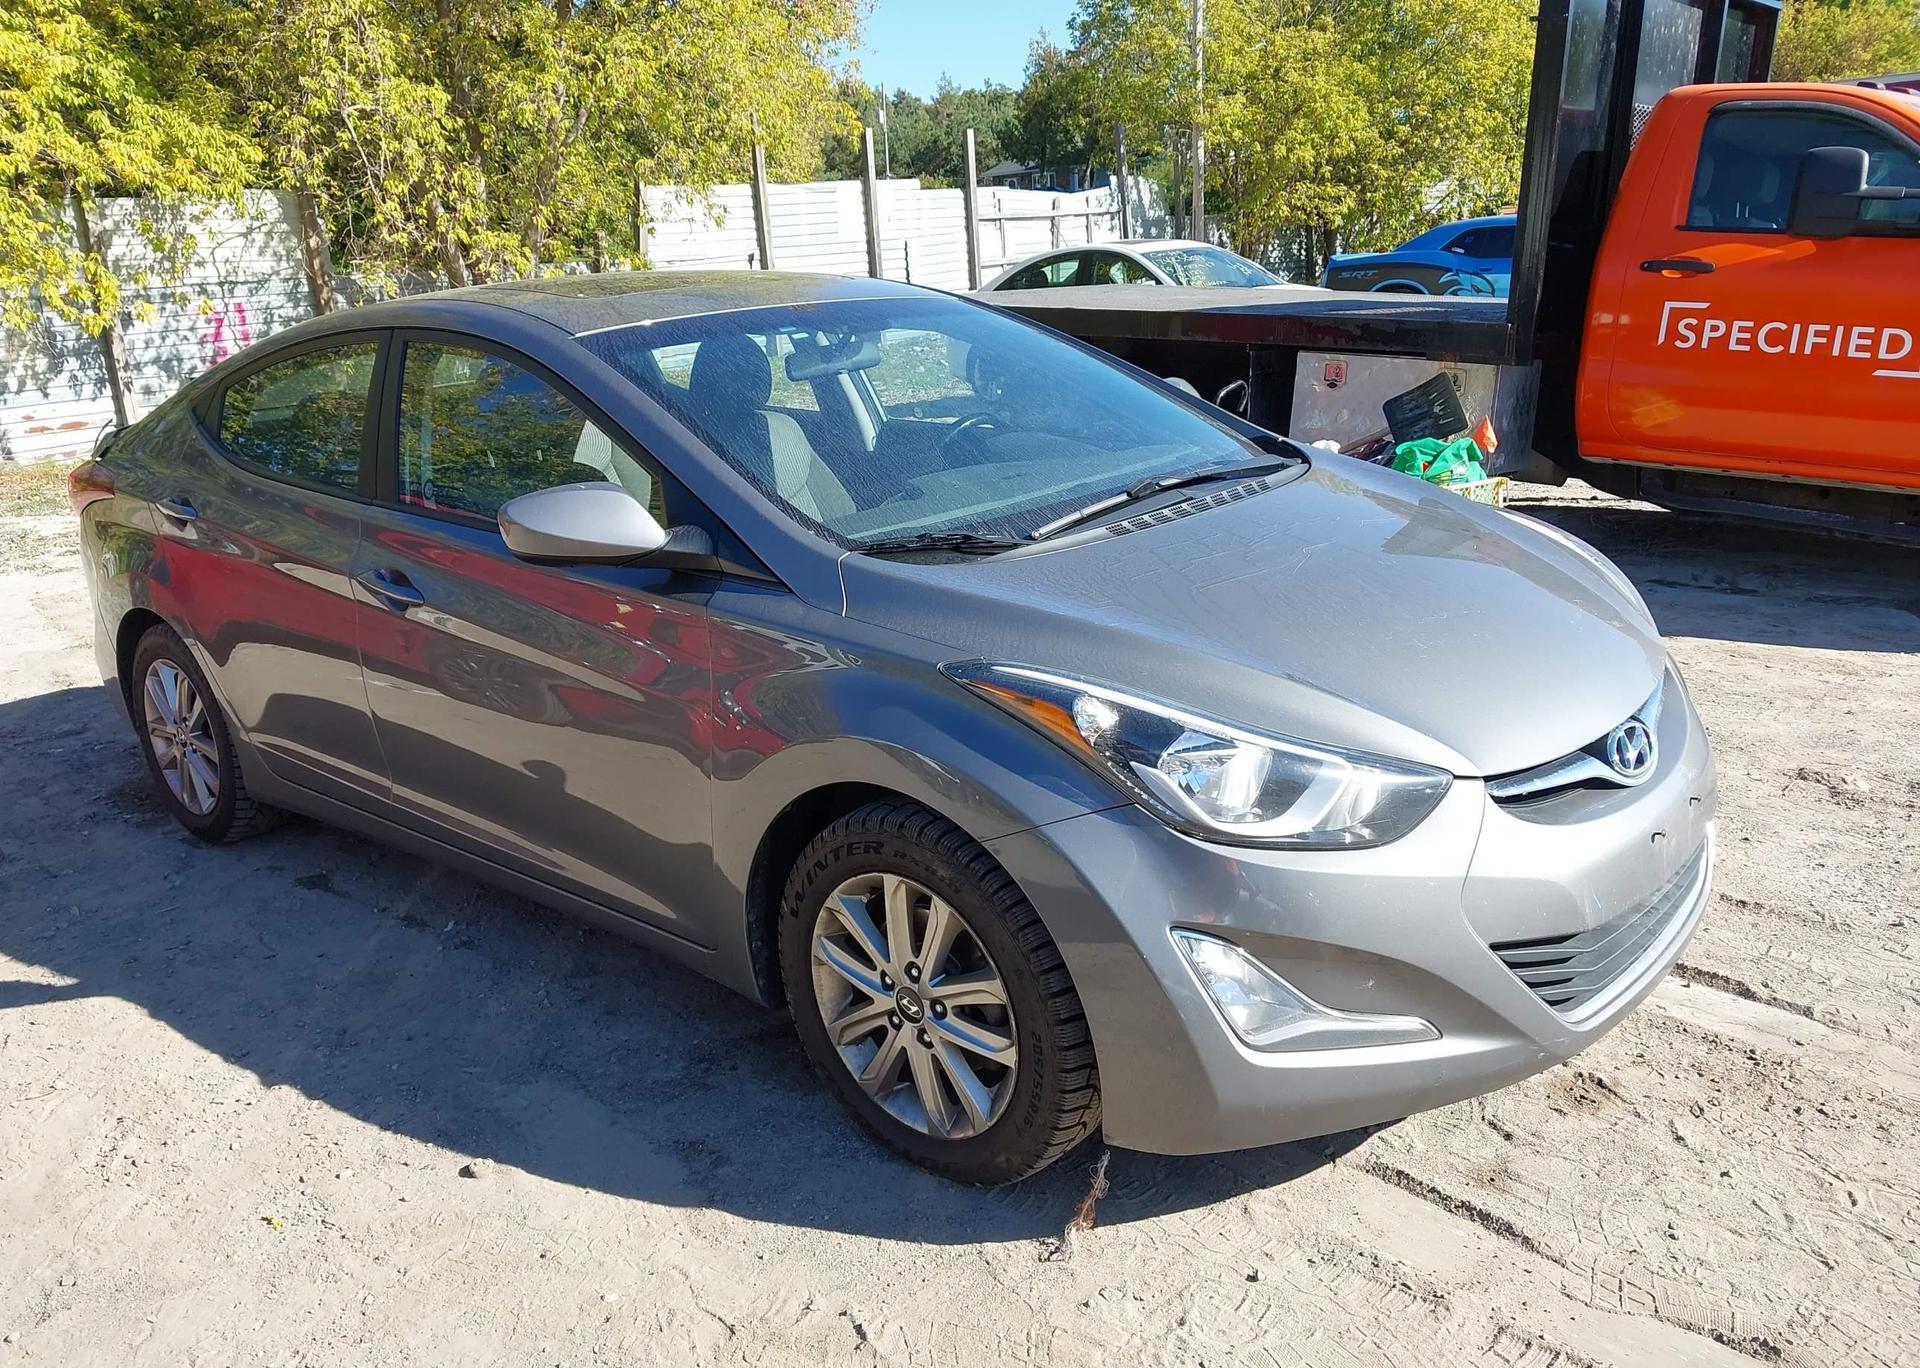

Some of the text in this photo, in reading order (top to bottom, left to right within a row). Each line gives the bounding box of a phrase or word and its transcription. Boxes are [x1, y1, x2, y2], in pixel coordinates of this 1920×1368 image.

[1673, 317, 1913, 361] SPECIFIED
[790, 841, 885, 918] WINTER
[1023, 1031, 1044, 1129] 205/55R16
